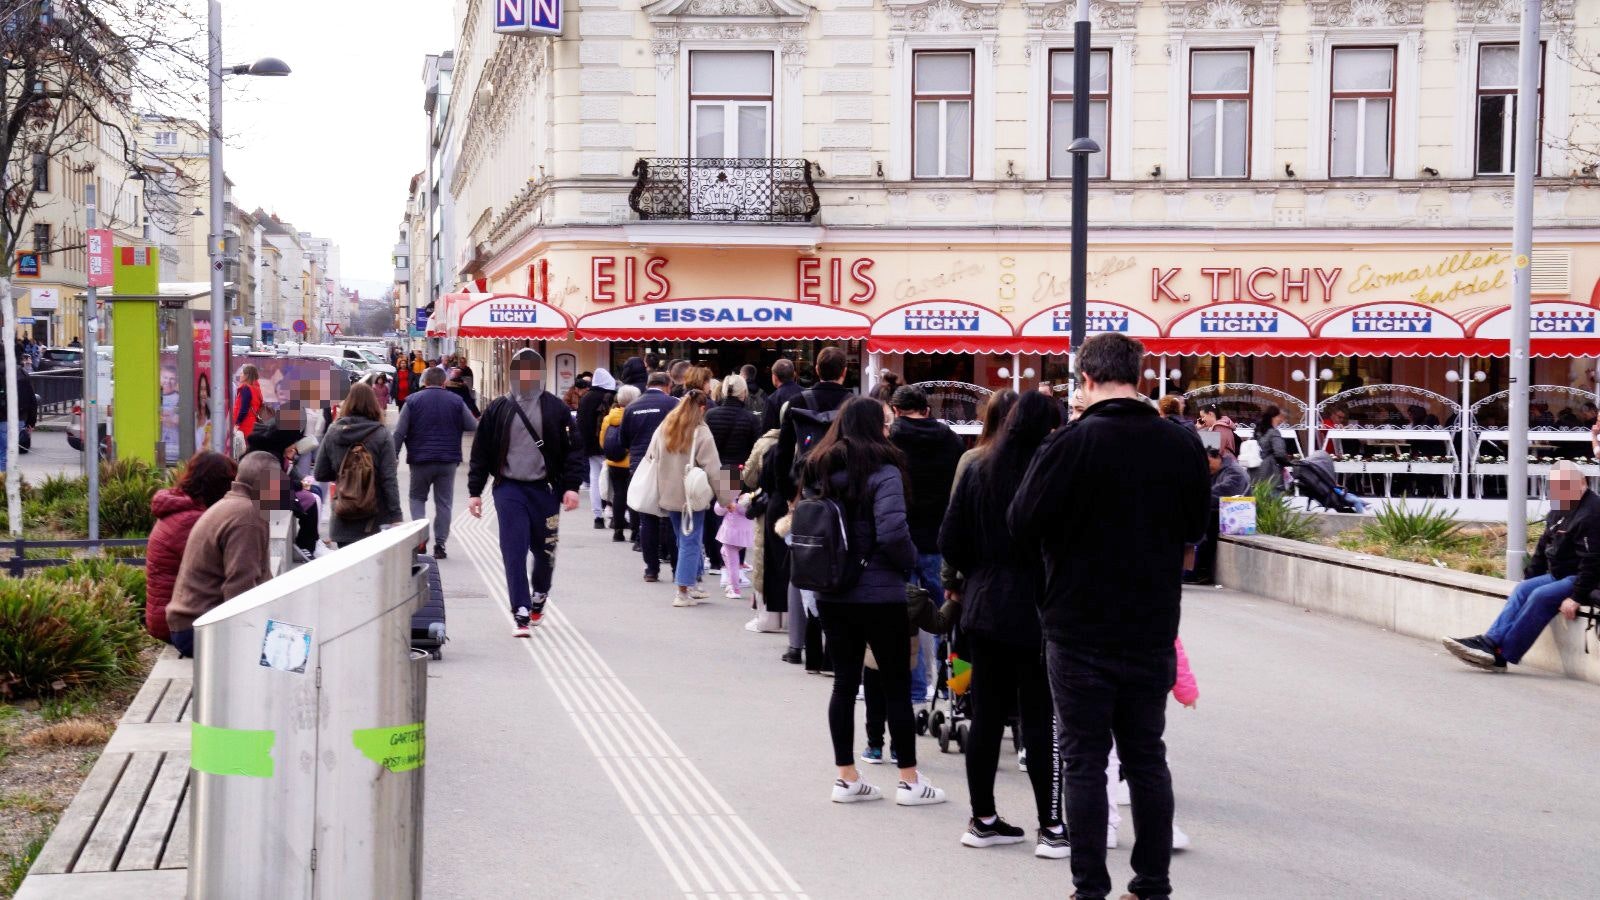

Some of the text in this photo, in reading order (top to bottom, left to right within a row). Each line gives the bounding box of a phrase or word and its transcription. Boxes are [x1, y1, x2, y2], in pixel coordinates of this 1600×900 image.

[592, 256, 671, 303] EIS
[797, 257, 877, 305] EIS
[1152, 266, 1343, 302] K. TICHY
[491, 311, 535, 322] TICHY
[655, 307, 792, 322] EISSALON
[907, 318, 976, 330] TICHY
[1056, 318, 1126, 331] THY
[1203, 319, 1273, 331] TICHY
[1355, 319, 1428, 331] TICHY
[1530, 319, 1591, 331] ICHY
